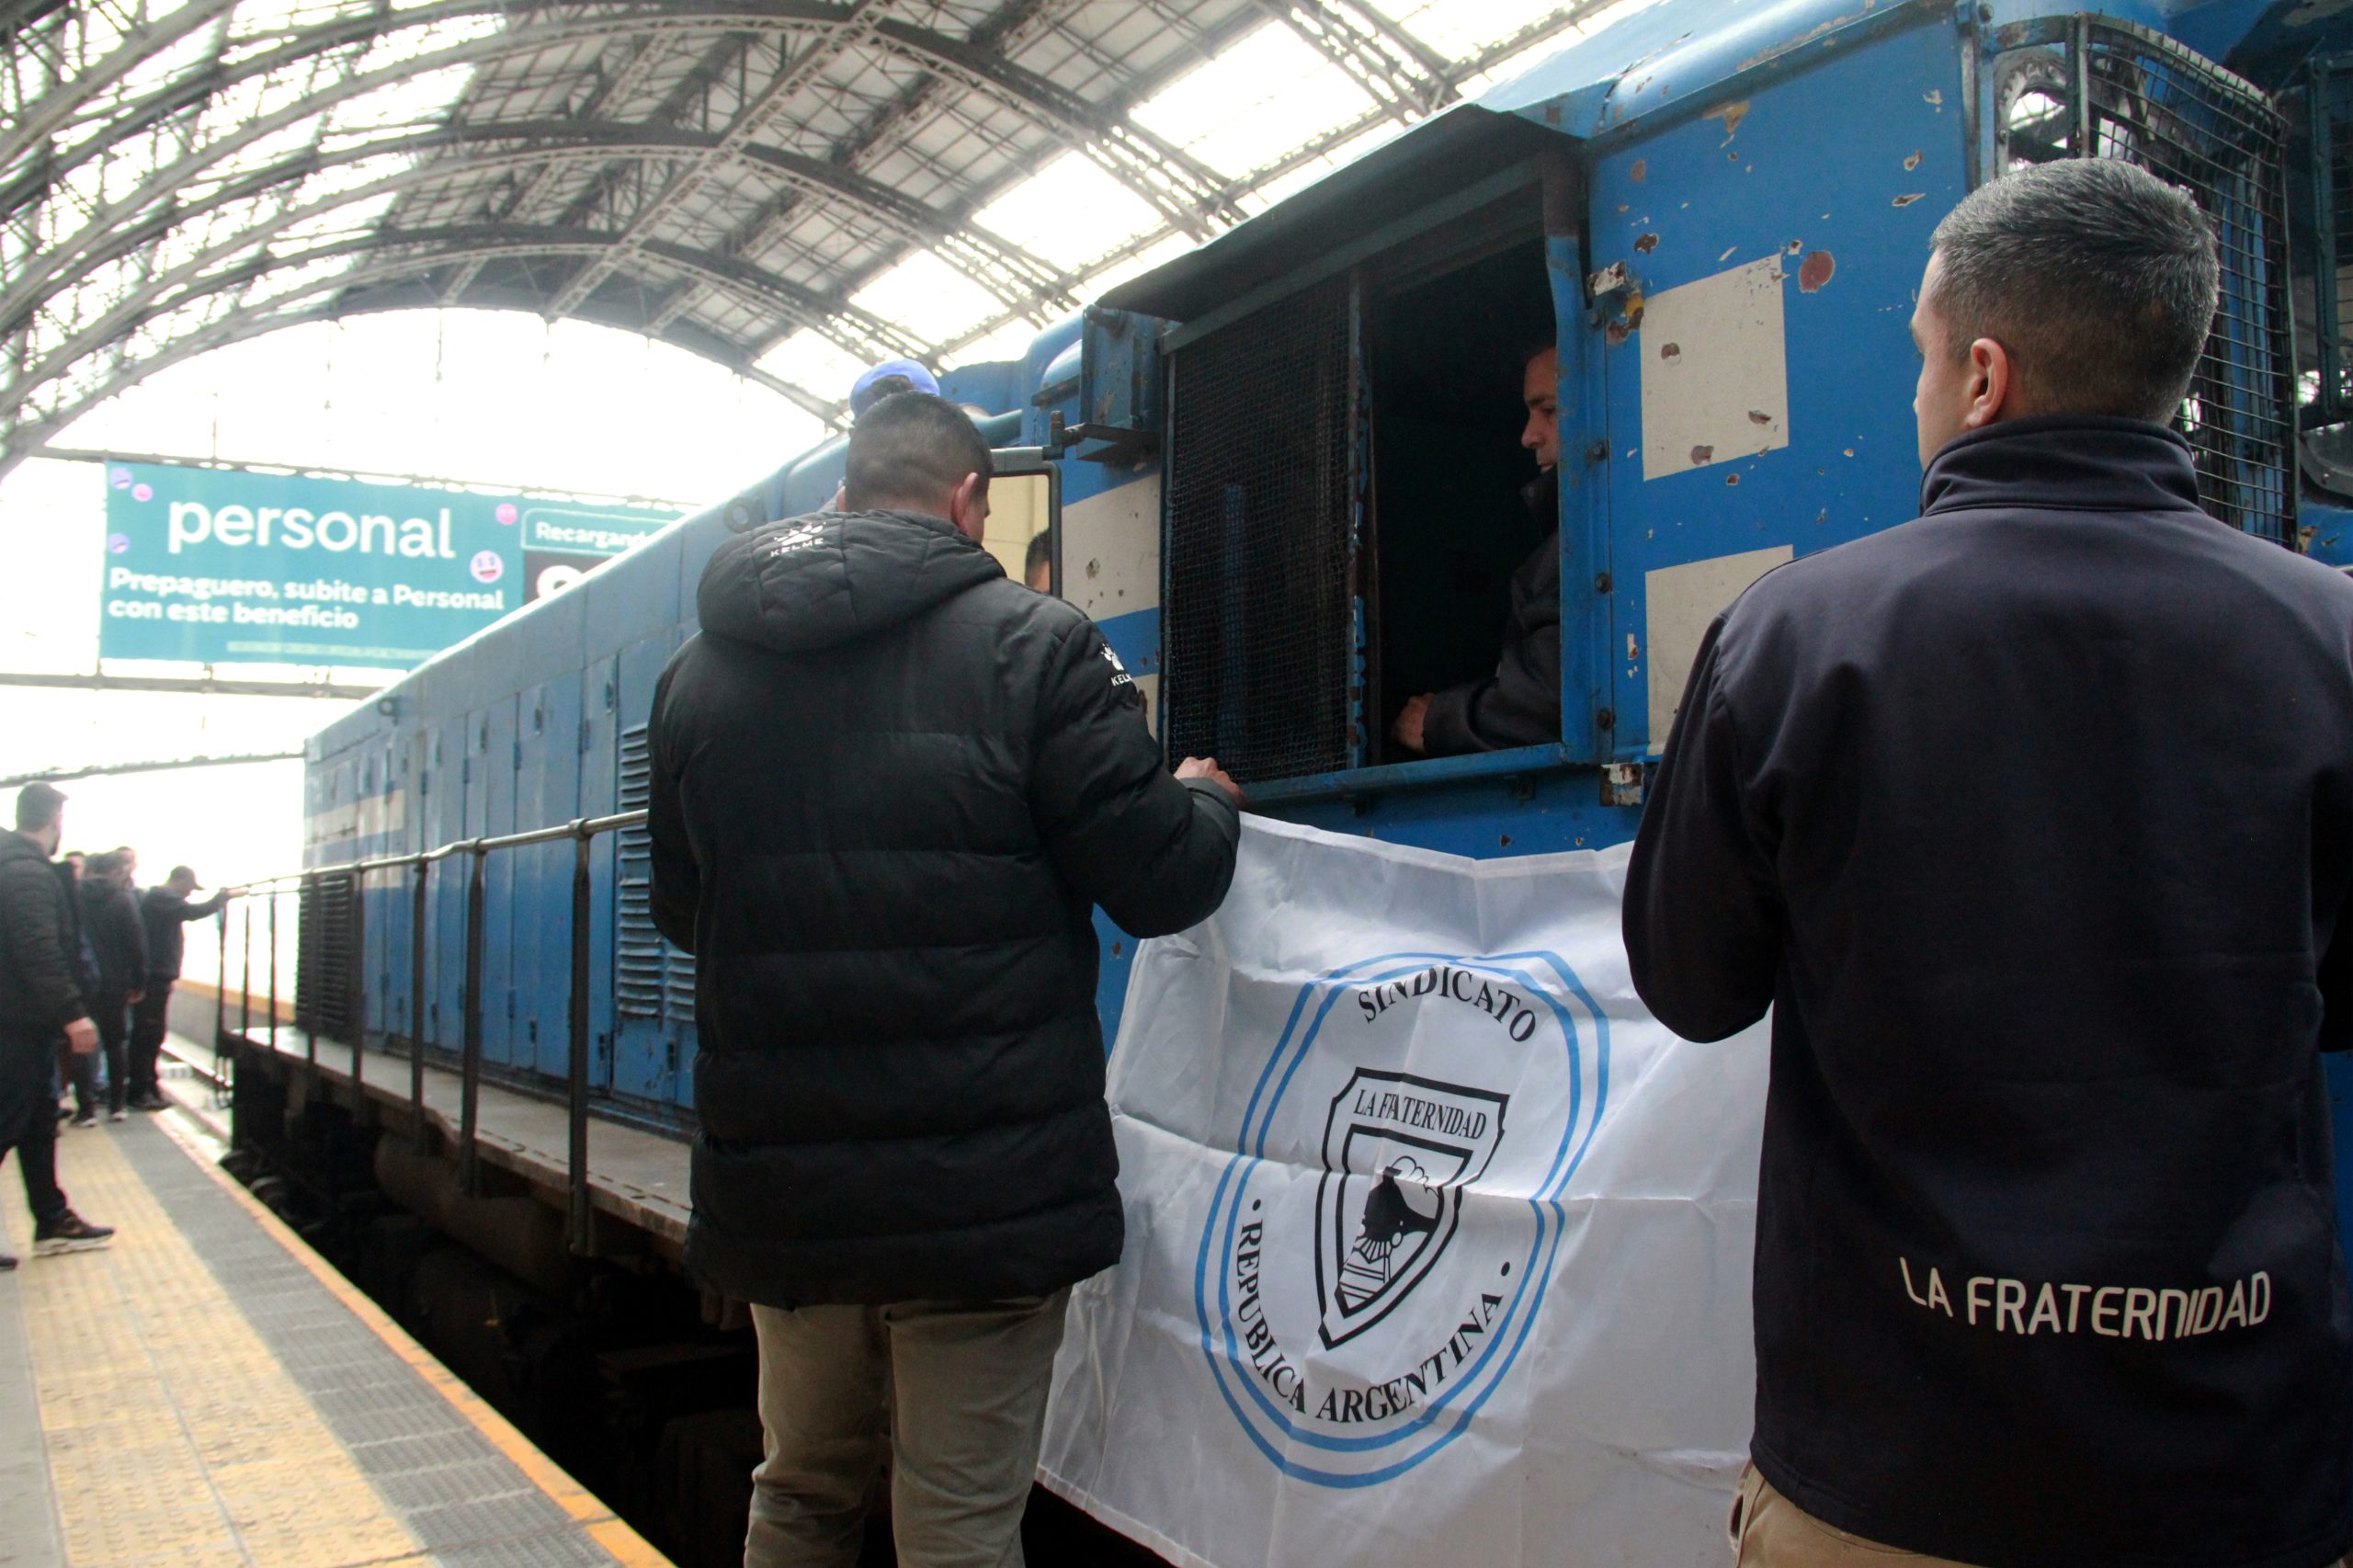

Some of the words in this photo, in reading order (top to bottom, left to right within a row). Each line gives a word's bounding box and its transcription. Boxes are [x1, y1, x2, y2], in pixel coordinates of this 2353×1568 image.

[168, 501, 457, 559] personal
[536, 521, 647, 549] Recargand
[770, 538, 824, 557] KELME
[109, 566, 279, 600] Prepaguero,
[283, 579, 367, 603] subite
[371, 586, 389, 605] a
[393, 584, 504, 610] Personal
[108, 599, 164, 619] con
[166, 602, 229, 623] este
[233, 601, 359, 630] beneficio
[1358, 966, 1536, 1042] SINDICATO
[1353, 1088, 1377, 1118] LA
[1900, 1256, 1954, 1318] LA
[1966, 1270, 2271, 1342] FRATERNIDAD
[1236, 1219, 1307, 1415] REPUBLICA
[1315, 1284, 1505, 1424] ARGENTINA
